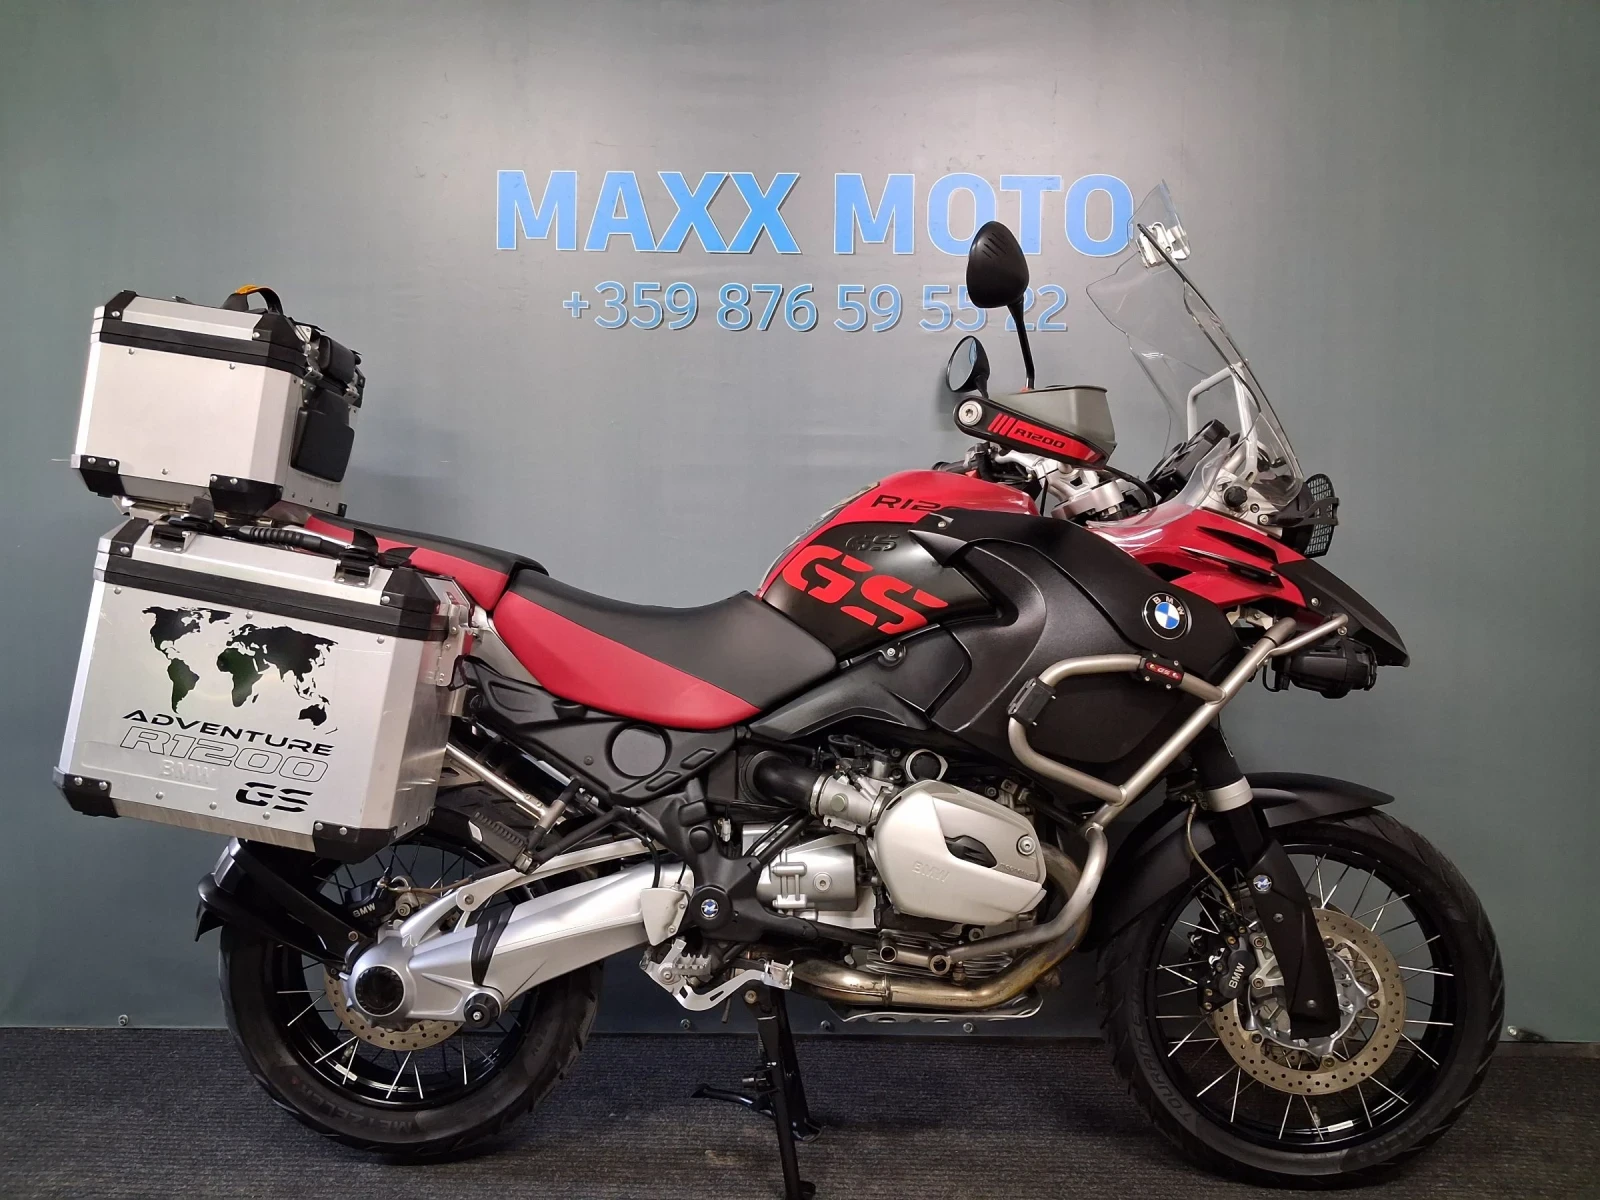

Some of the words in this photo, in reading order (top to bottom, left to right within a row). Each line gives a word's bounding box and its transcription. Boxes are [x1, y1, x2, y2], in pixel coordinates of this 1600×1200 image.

[496, 169, 801, 255] MAXX
[833, 173, 1134, 257] MOTO
[562, 281, 698, 331] +359
[716, 283, 818, 331] 876
[834, 284, 902, 332] 59
[918, 284, 989, 332] 55
[1003, 284, 1068, 332] 22
[1013, 427, 1066, 449] R1200
[845, 534, 900, 551] GS
[782, 544, 949, 635] GS
[1152, 595, 1185, 616] BMW
[122, 709, 335, 757] ADVENTURE
[120, 726, 329, 783] R1200
[161, 758, 217, 785] BMW
[235, 781, 314, 813] GS
[911, 860, 951, 883] BMW
[352, 902, 376, 918] BMW
[1228, 962, 1246, 989] BMW
